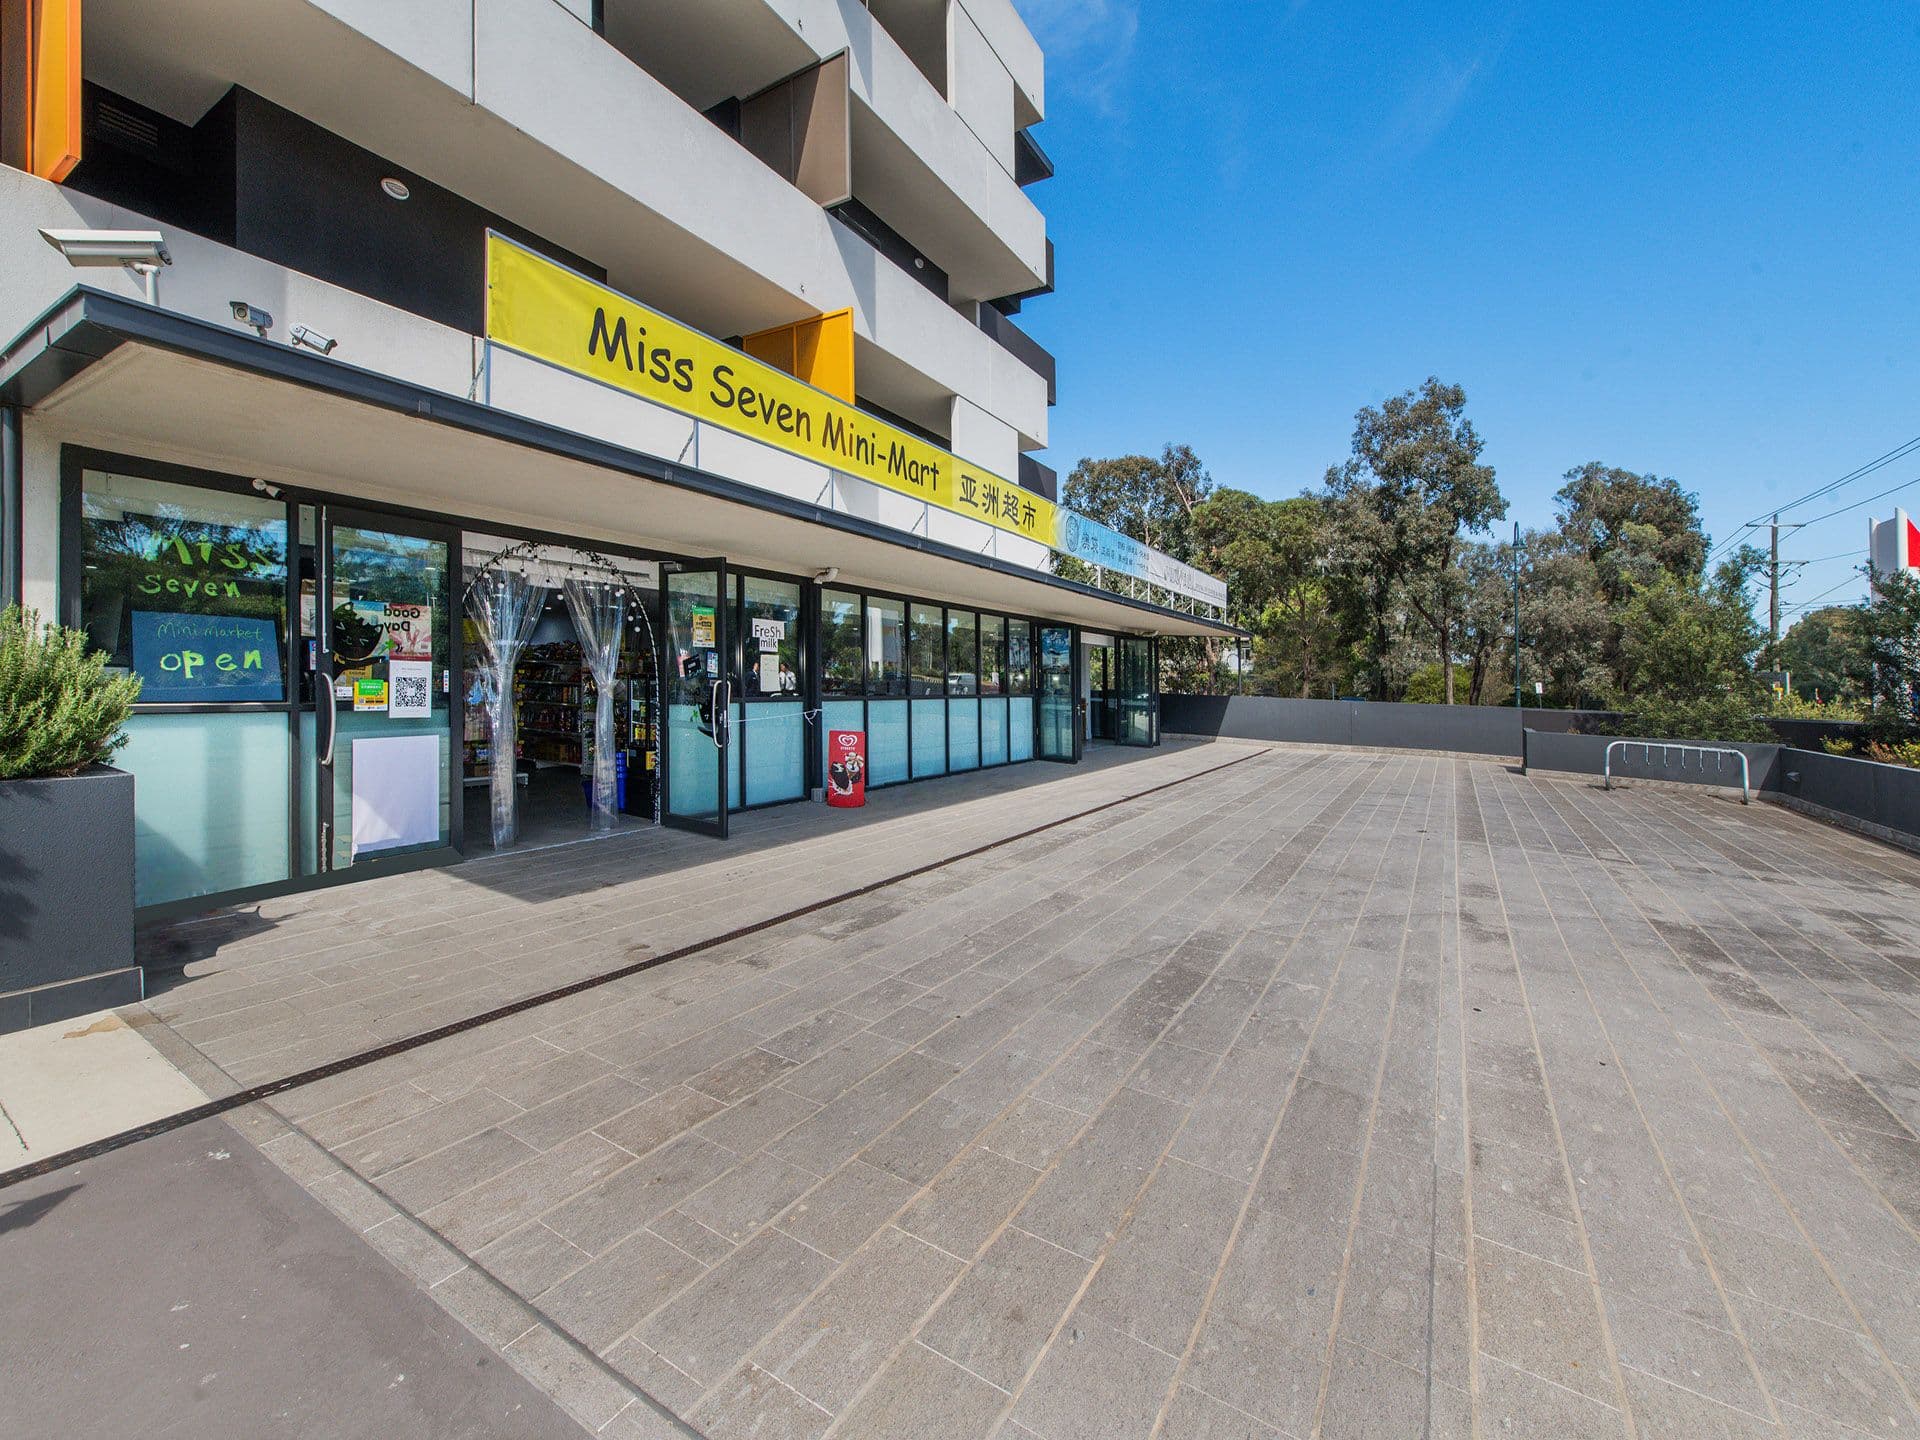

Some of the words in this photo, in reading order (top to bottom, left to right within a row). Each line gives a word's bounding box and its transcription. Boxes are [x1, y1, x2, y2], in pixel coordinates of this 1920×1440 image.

[588, 307, 694, 392] Miss
[710, 365, 811, 442] Seven
[822, 411, 939, 491] Mini-Mart
[959, 474, 1036, 532] 亚洲超市
[160, 650, 262, 679] open
[760, 638, 777, 649] milk
